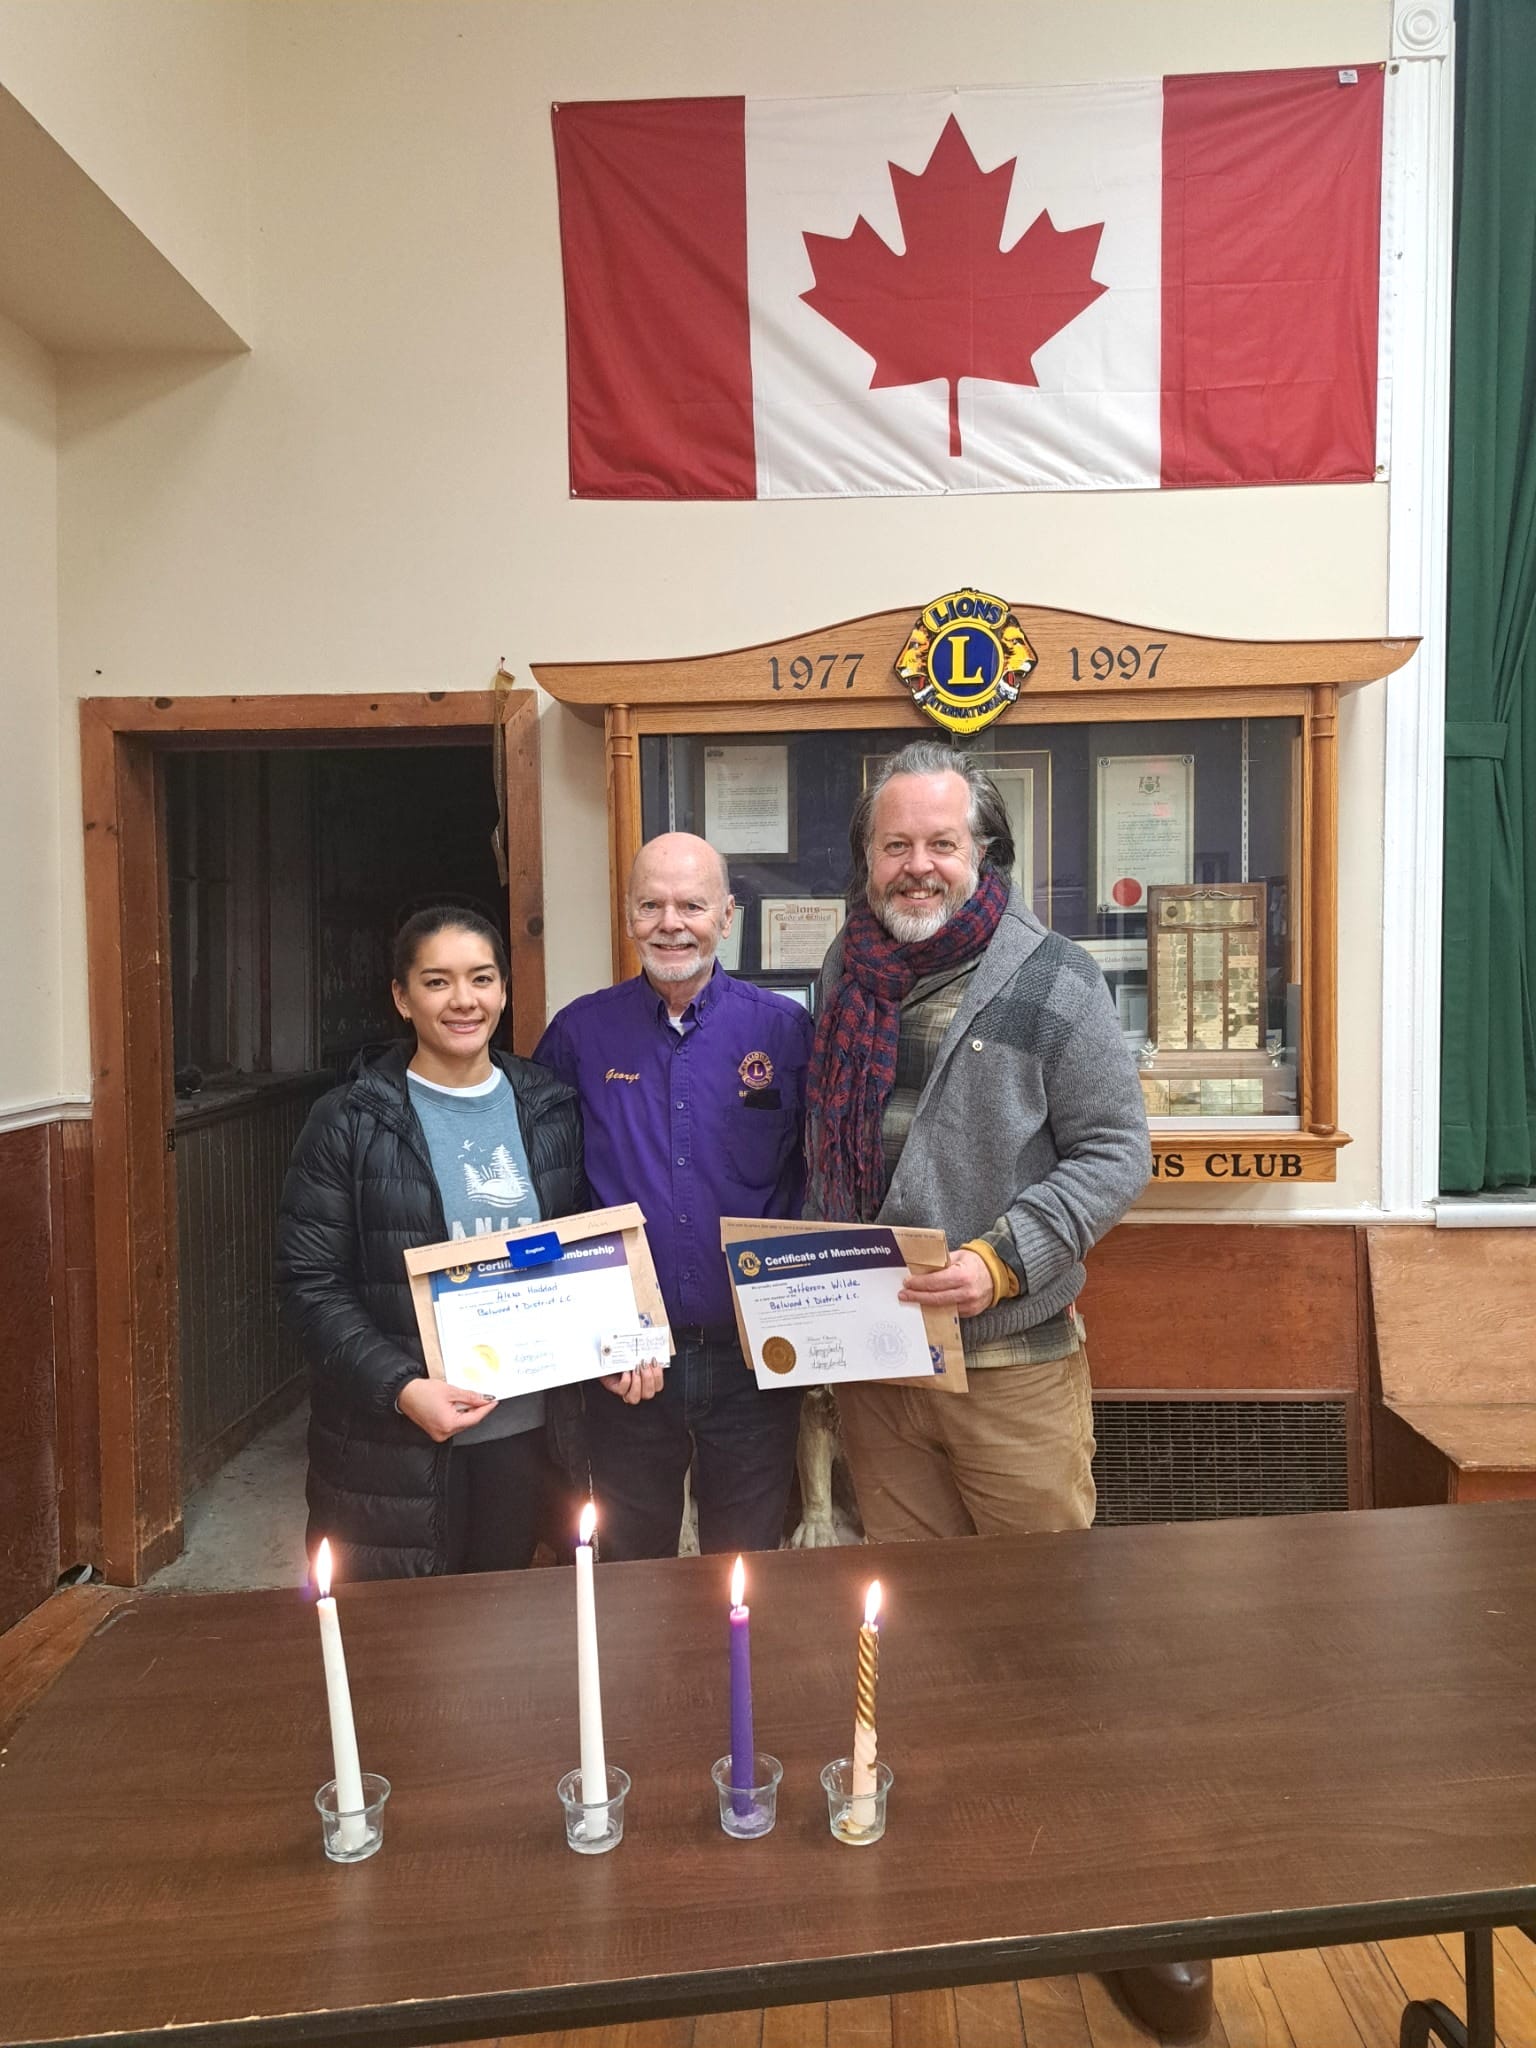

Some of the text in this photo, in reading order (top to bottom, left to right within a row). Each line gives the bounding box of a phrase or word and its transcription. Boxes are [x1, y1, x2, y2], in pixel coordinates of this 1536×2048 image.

[929, 597, 1003, 627] LIONS
[767, 653, 864, 691] 1977
[947, 635, 985, 685] L
[1067, 643, 1168, 682] 1997
[605, 1068, 640, 1084] George
[753, 1063, 764, 1077] L
[1205, 1153, 1302, 1178] CLUB
[477, 1244, 616, 1273] Certifi embership
[764, 1251, 817, 1267] Certificate
[818, 1249, 829, 1260] of
[830, 1245, 892, 1258] Membership
